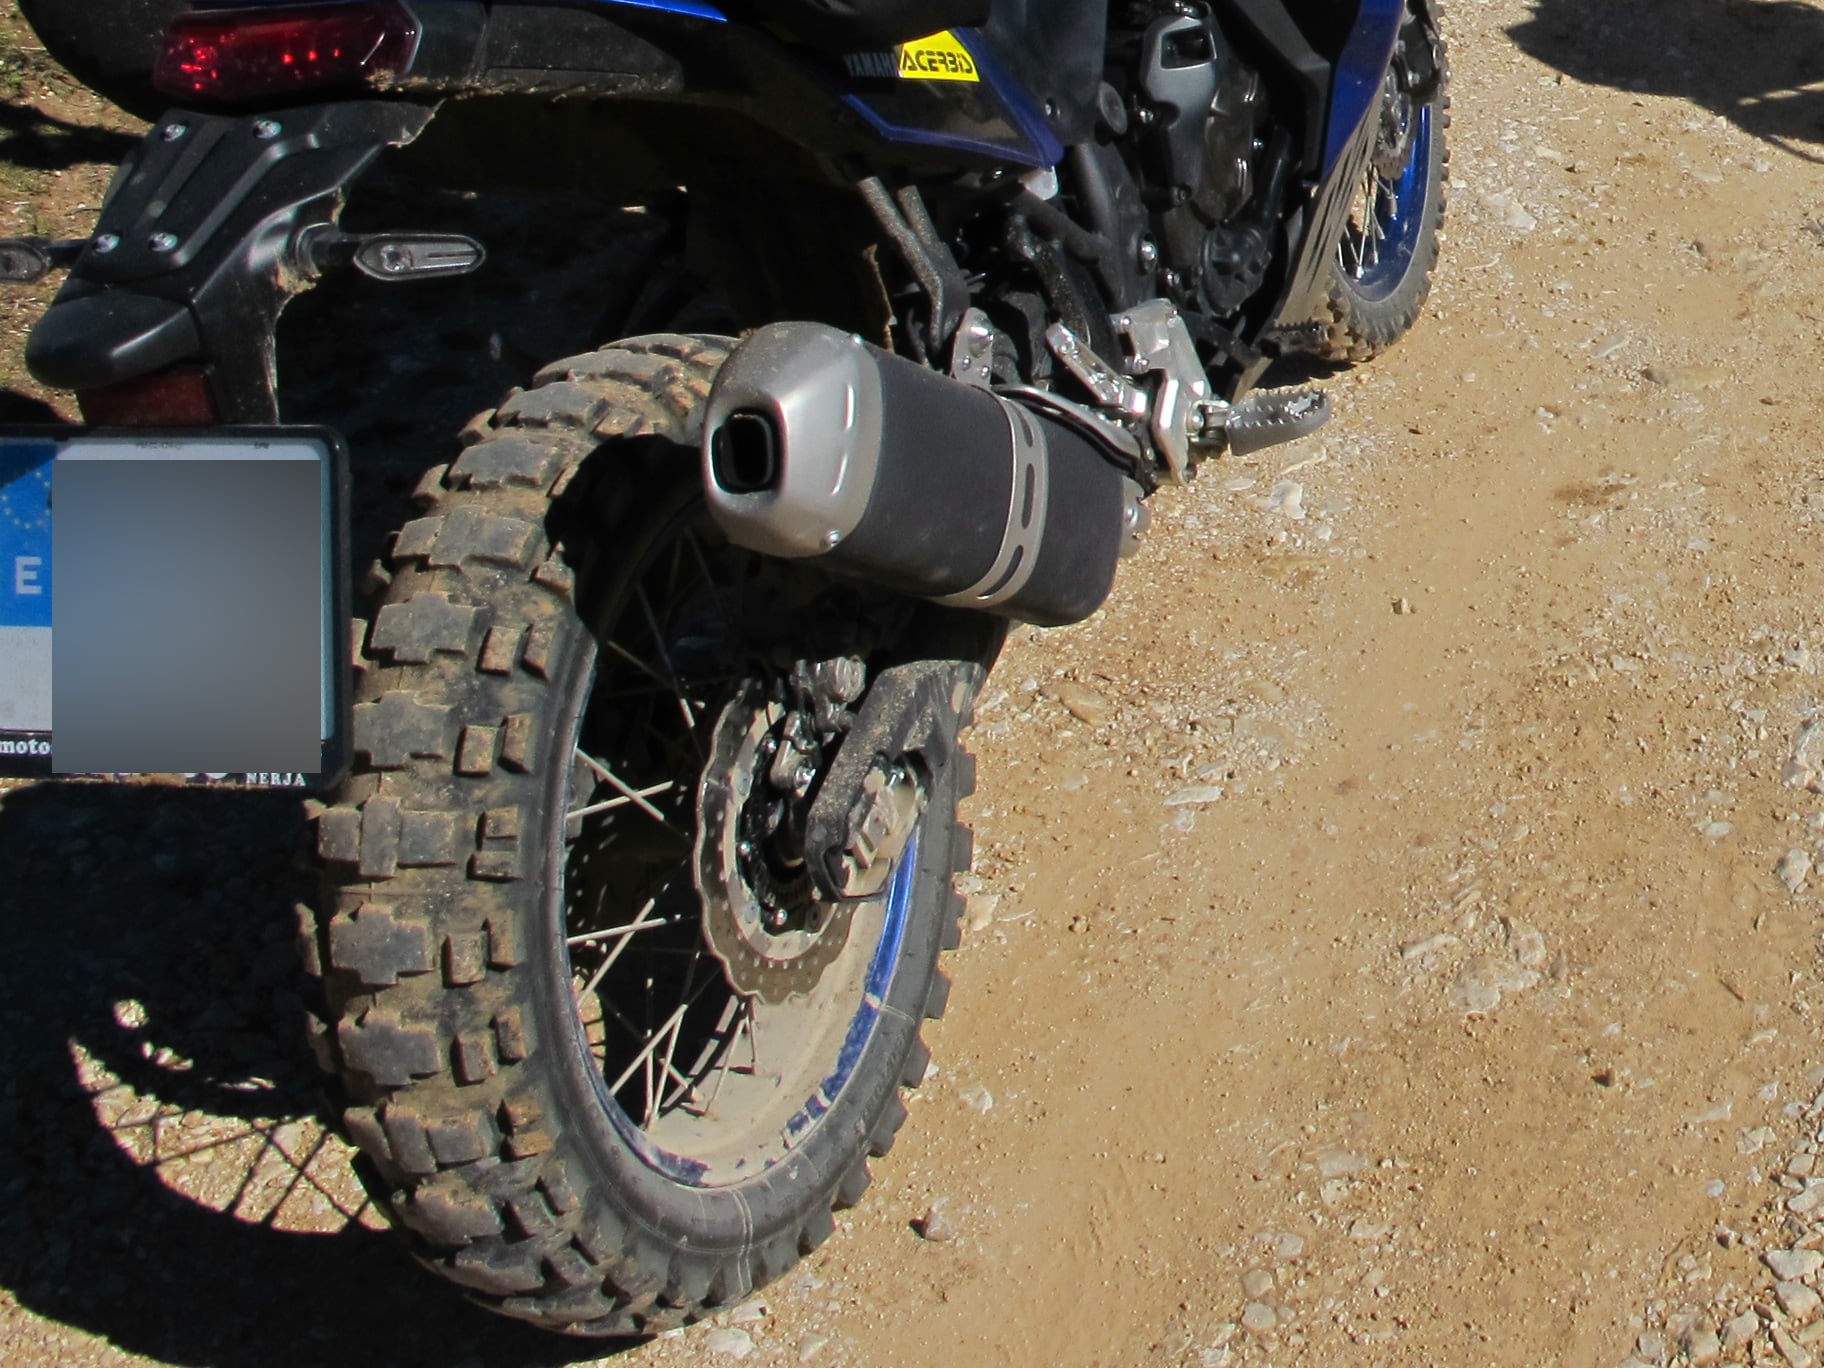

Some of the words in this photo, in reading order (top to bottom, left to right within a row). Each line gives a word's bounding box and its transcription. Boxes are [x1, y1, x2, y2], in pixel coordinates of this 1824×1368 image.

[843, 52, 900, 77] YAMAH
[15, 556, 43, 595] E
[0, 738, 52, 756] moto
[247, 773, 307, 787] NERJA
